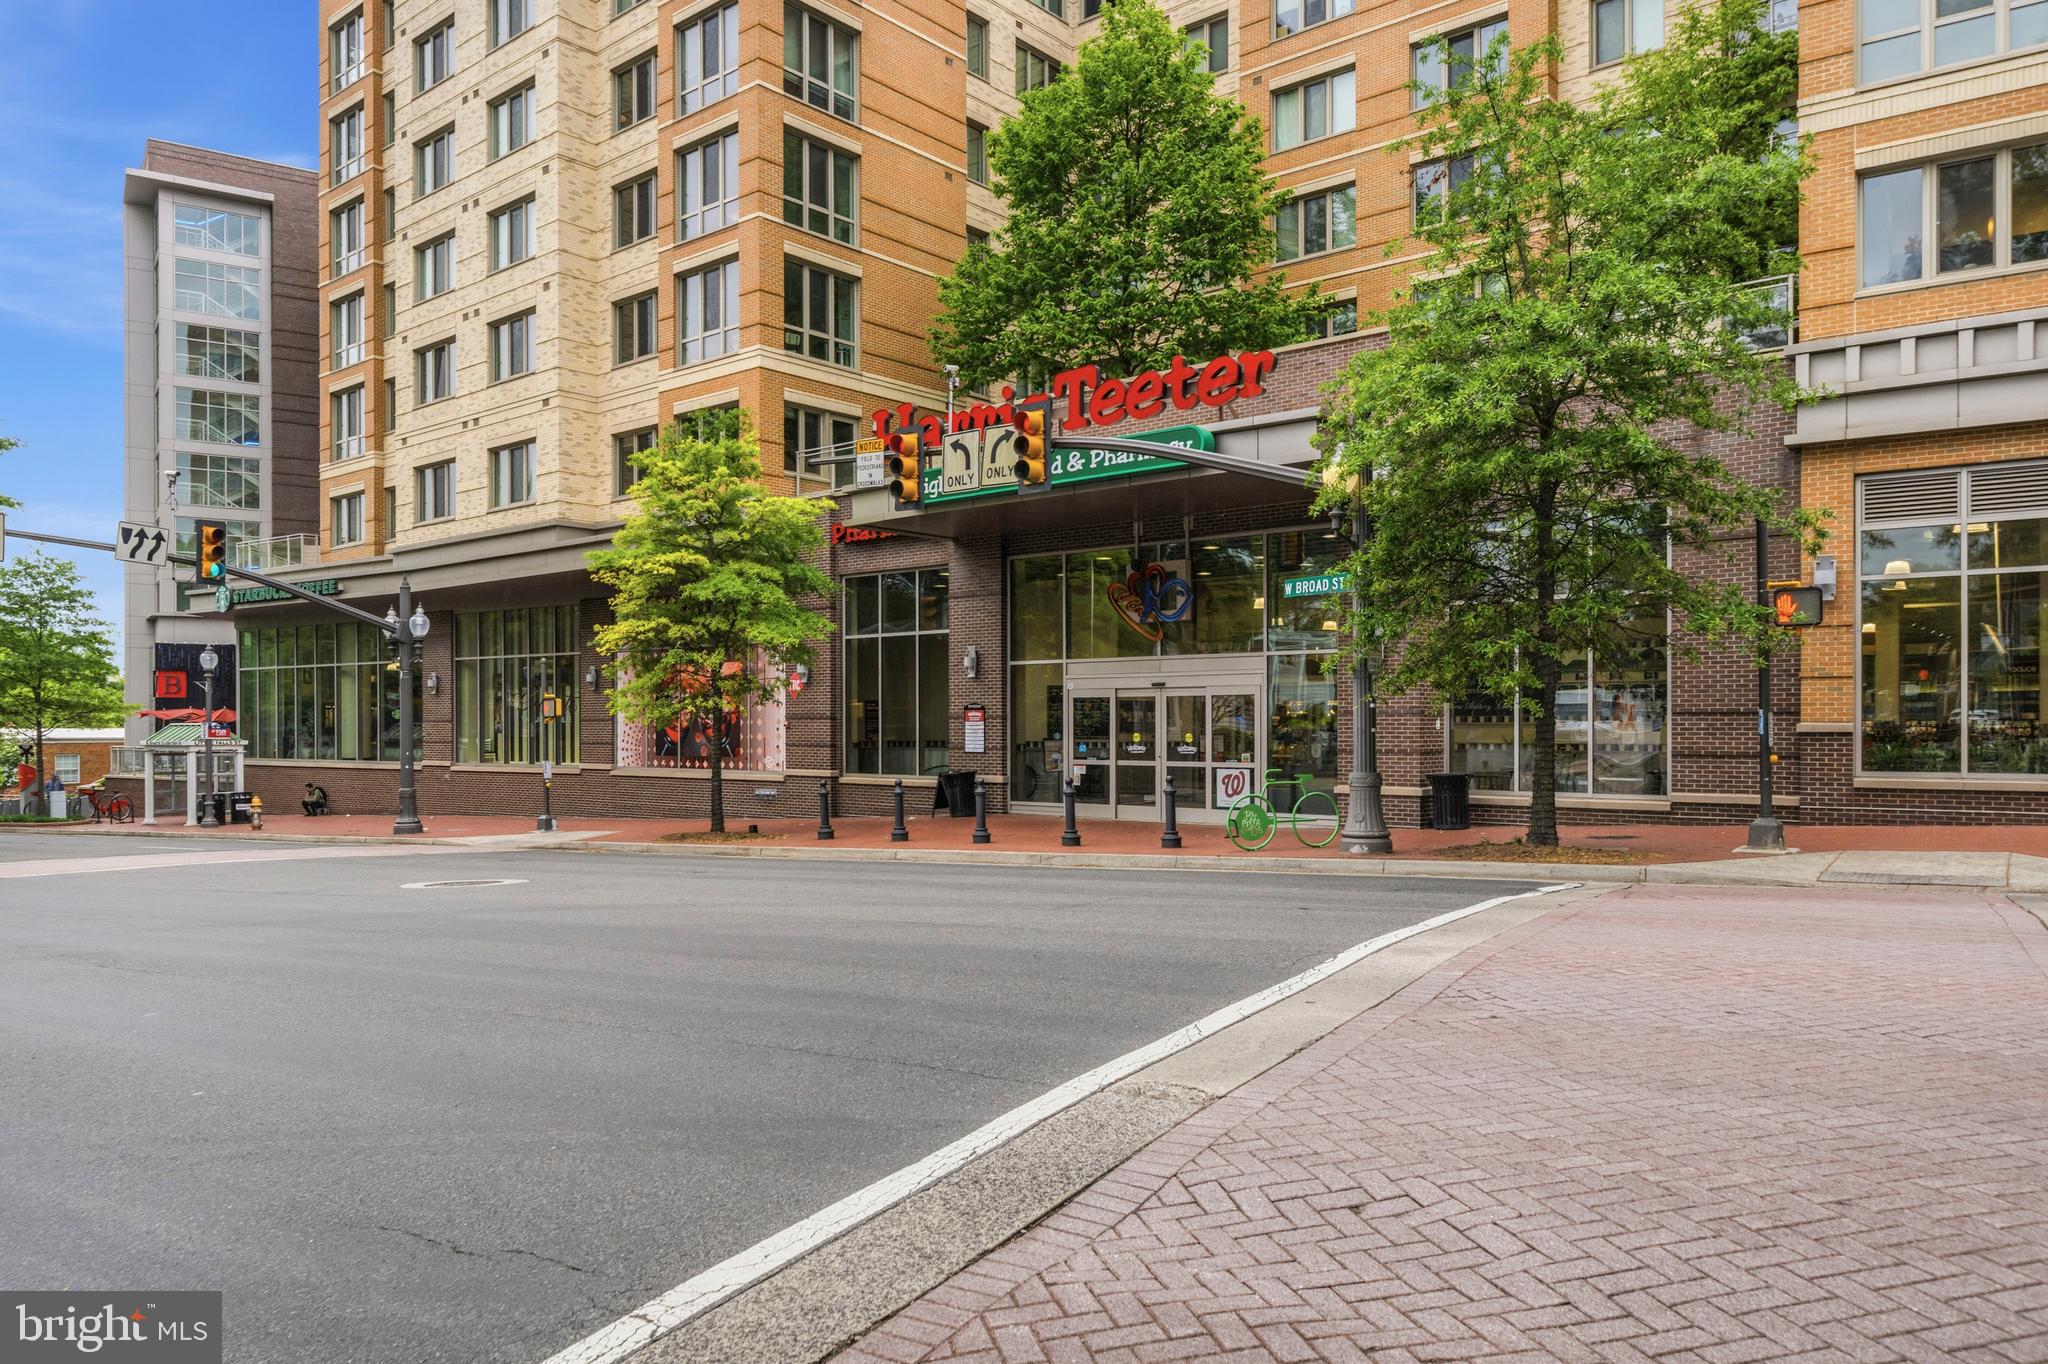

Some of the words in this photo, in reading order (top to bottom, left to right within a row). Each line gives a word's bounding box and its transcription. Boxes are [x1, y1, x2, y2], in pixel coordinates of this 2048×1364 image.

[872, 386, 1048, 447] Harri
[1053, 350, 1277, 431] Teeter
[858, 440, 883, 452] NOTICE
[1066, 451, 1086, 472] &
[947, 473, 975, 488] ONLY
[986, 465, 1015, 479] ONLY
[1284, 583, 1292, 595] W
[1295, 579, 1329, 594] BROAD
[1332, 576, 1345, 590] ST
[164, 674, 181, 695] B
